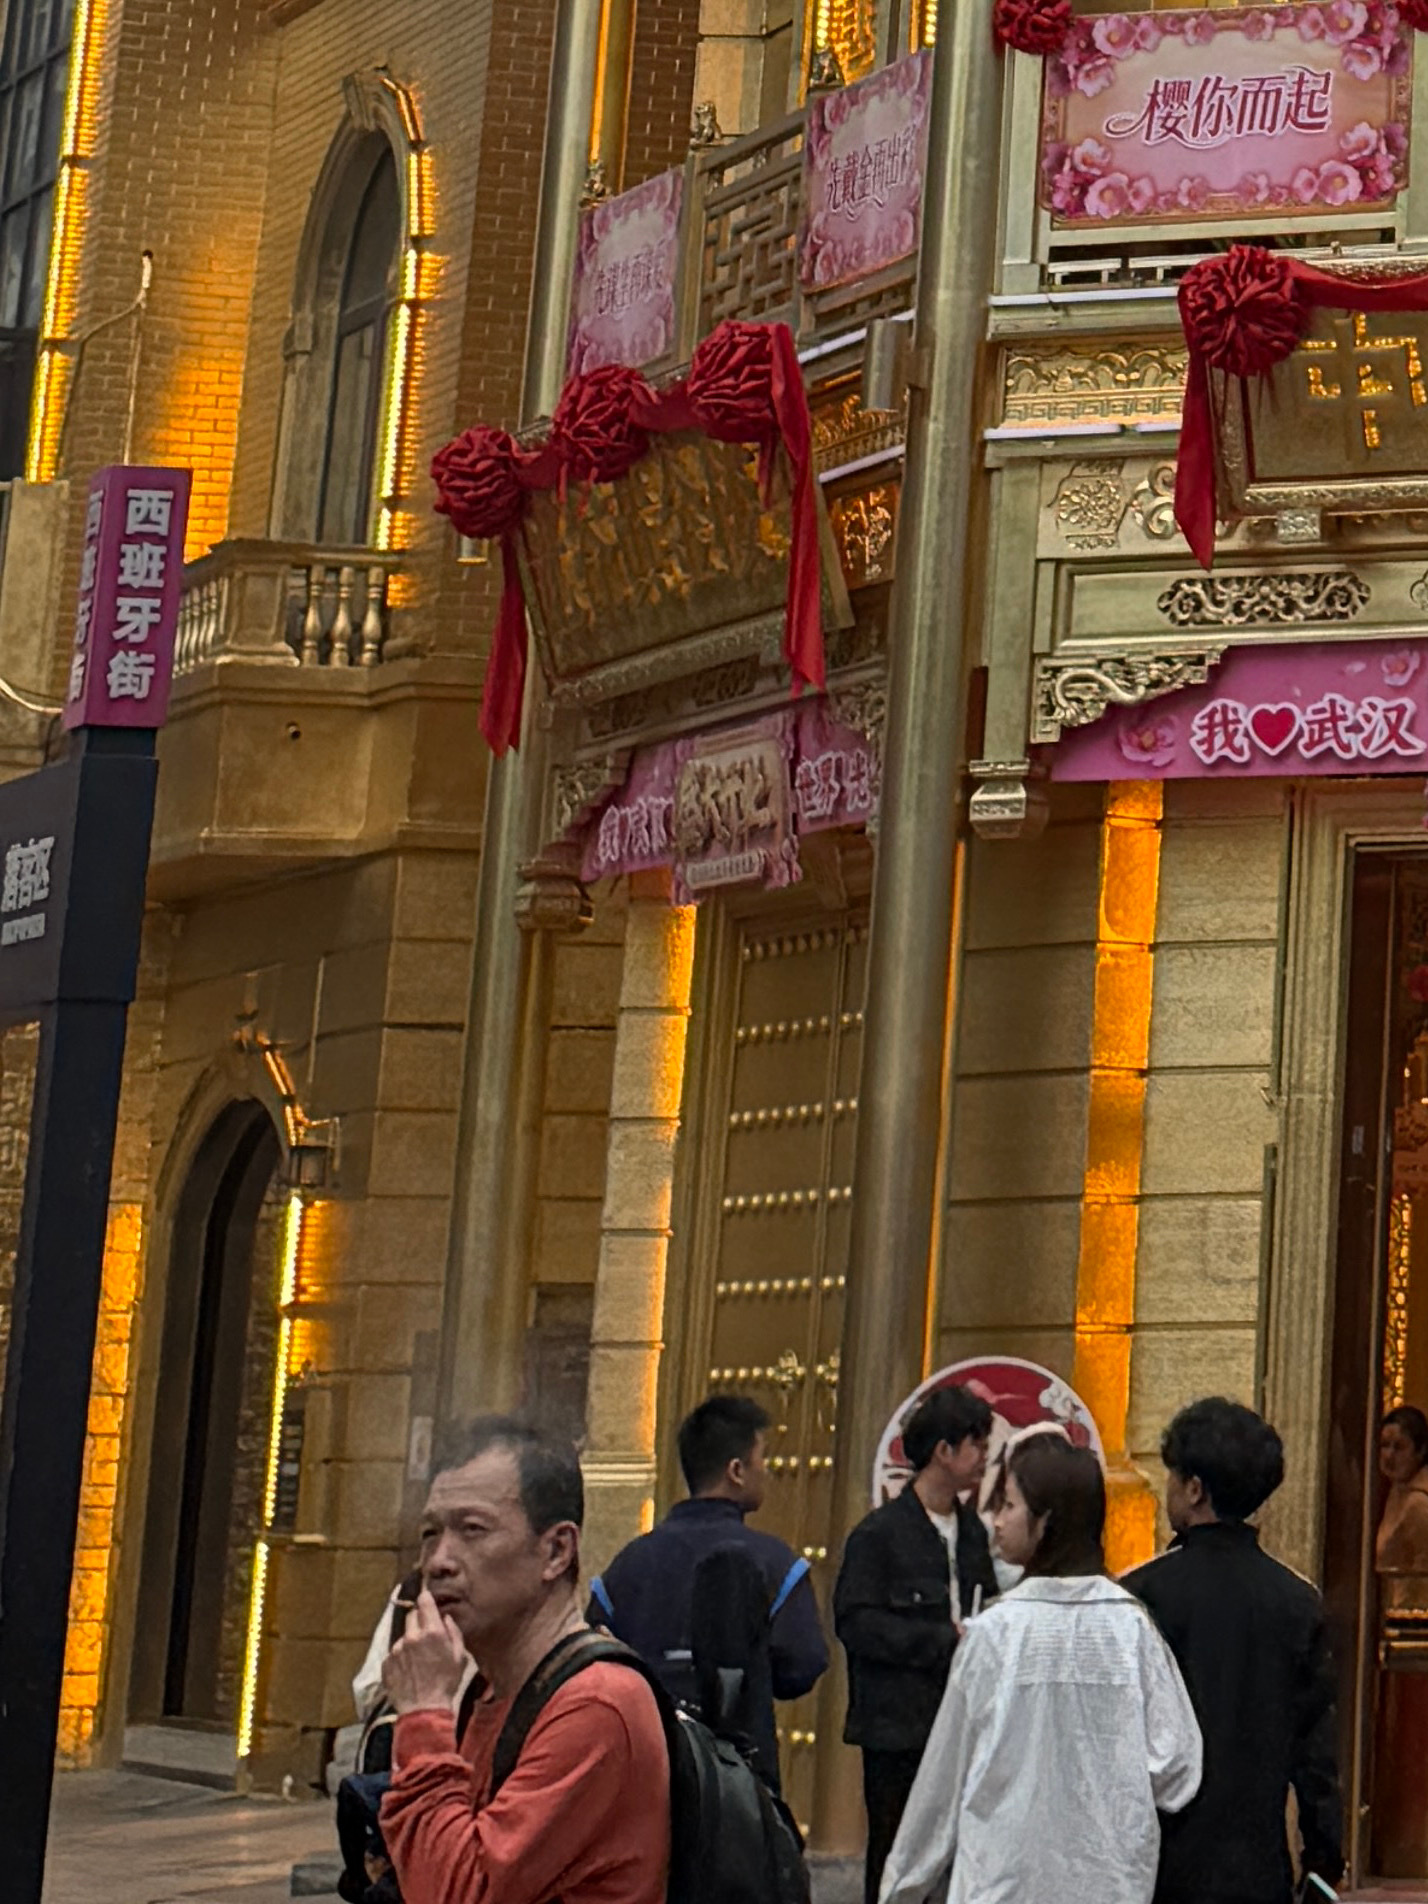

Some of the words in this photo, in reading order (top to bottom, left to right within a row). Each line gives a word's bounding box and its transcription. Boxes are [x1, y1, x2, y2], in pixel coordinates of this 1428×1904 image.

[1104, 64, 1334, 148] 樱你而起
[107, 488, 174, 700] 西班牙街
[1190, 700, 1246, 761] 我
[1300, 696, 1420, 759] 武汉
